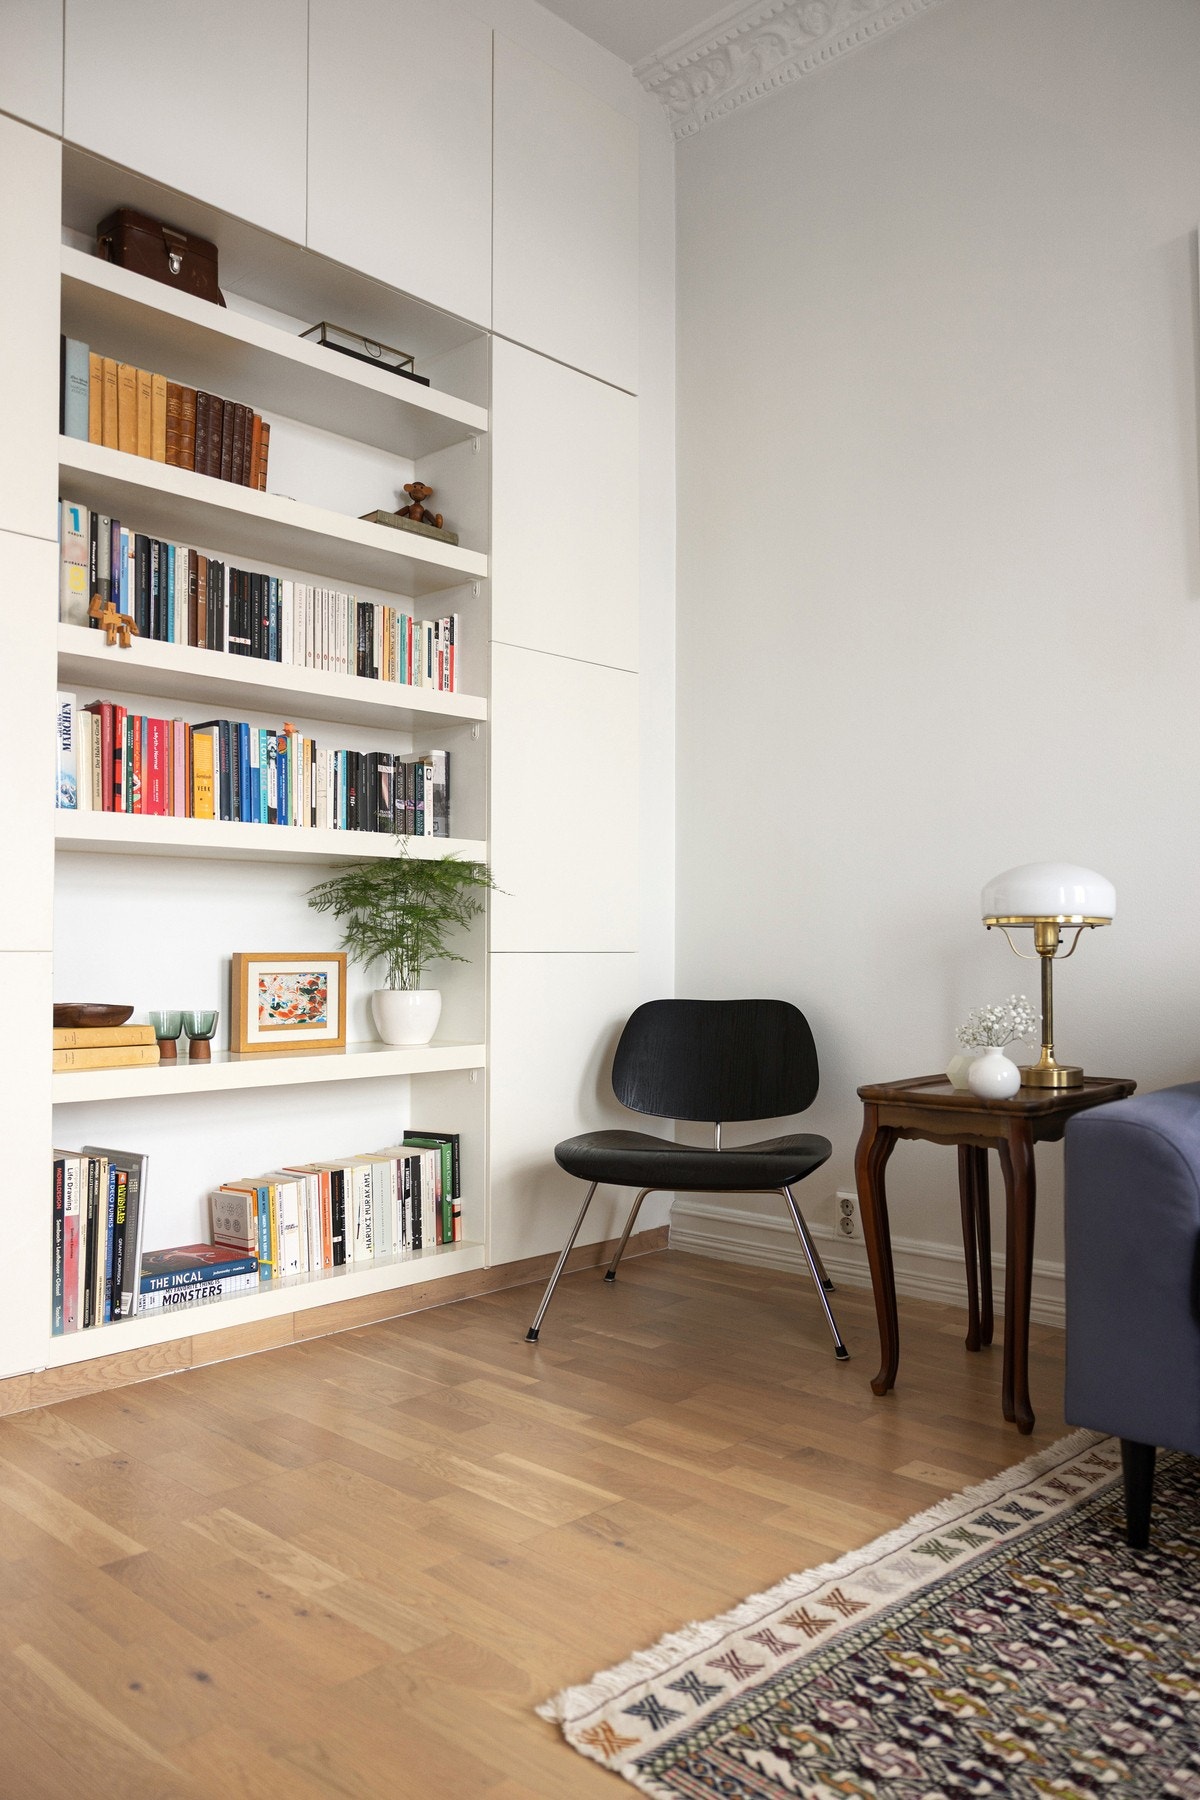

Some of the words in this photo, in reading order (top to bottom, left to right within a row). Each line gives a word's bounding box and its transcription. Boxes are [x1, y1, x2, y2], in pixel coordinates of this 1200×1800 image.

[69, 507, 80, 532] 1
[69, 565, 86, 592] 8
[363, 1173, 371, 1215] MURAKAMI
[364, 1217, 372, 1249] HARUKI
[150, 1276, 170, 1290] THE
[172, 1271, 203, 1286] INCAL
[174, 1284, 198, 1292] FAVORITE
[162, 1284, 223, 1307] MONSTERS
